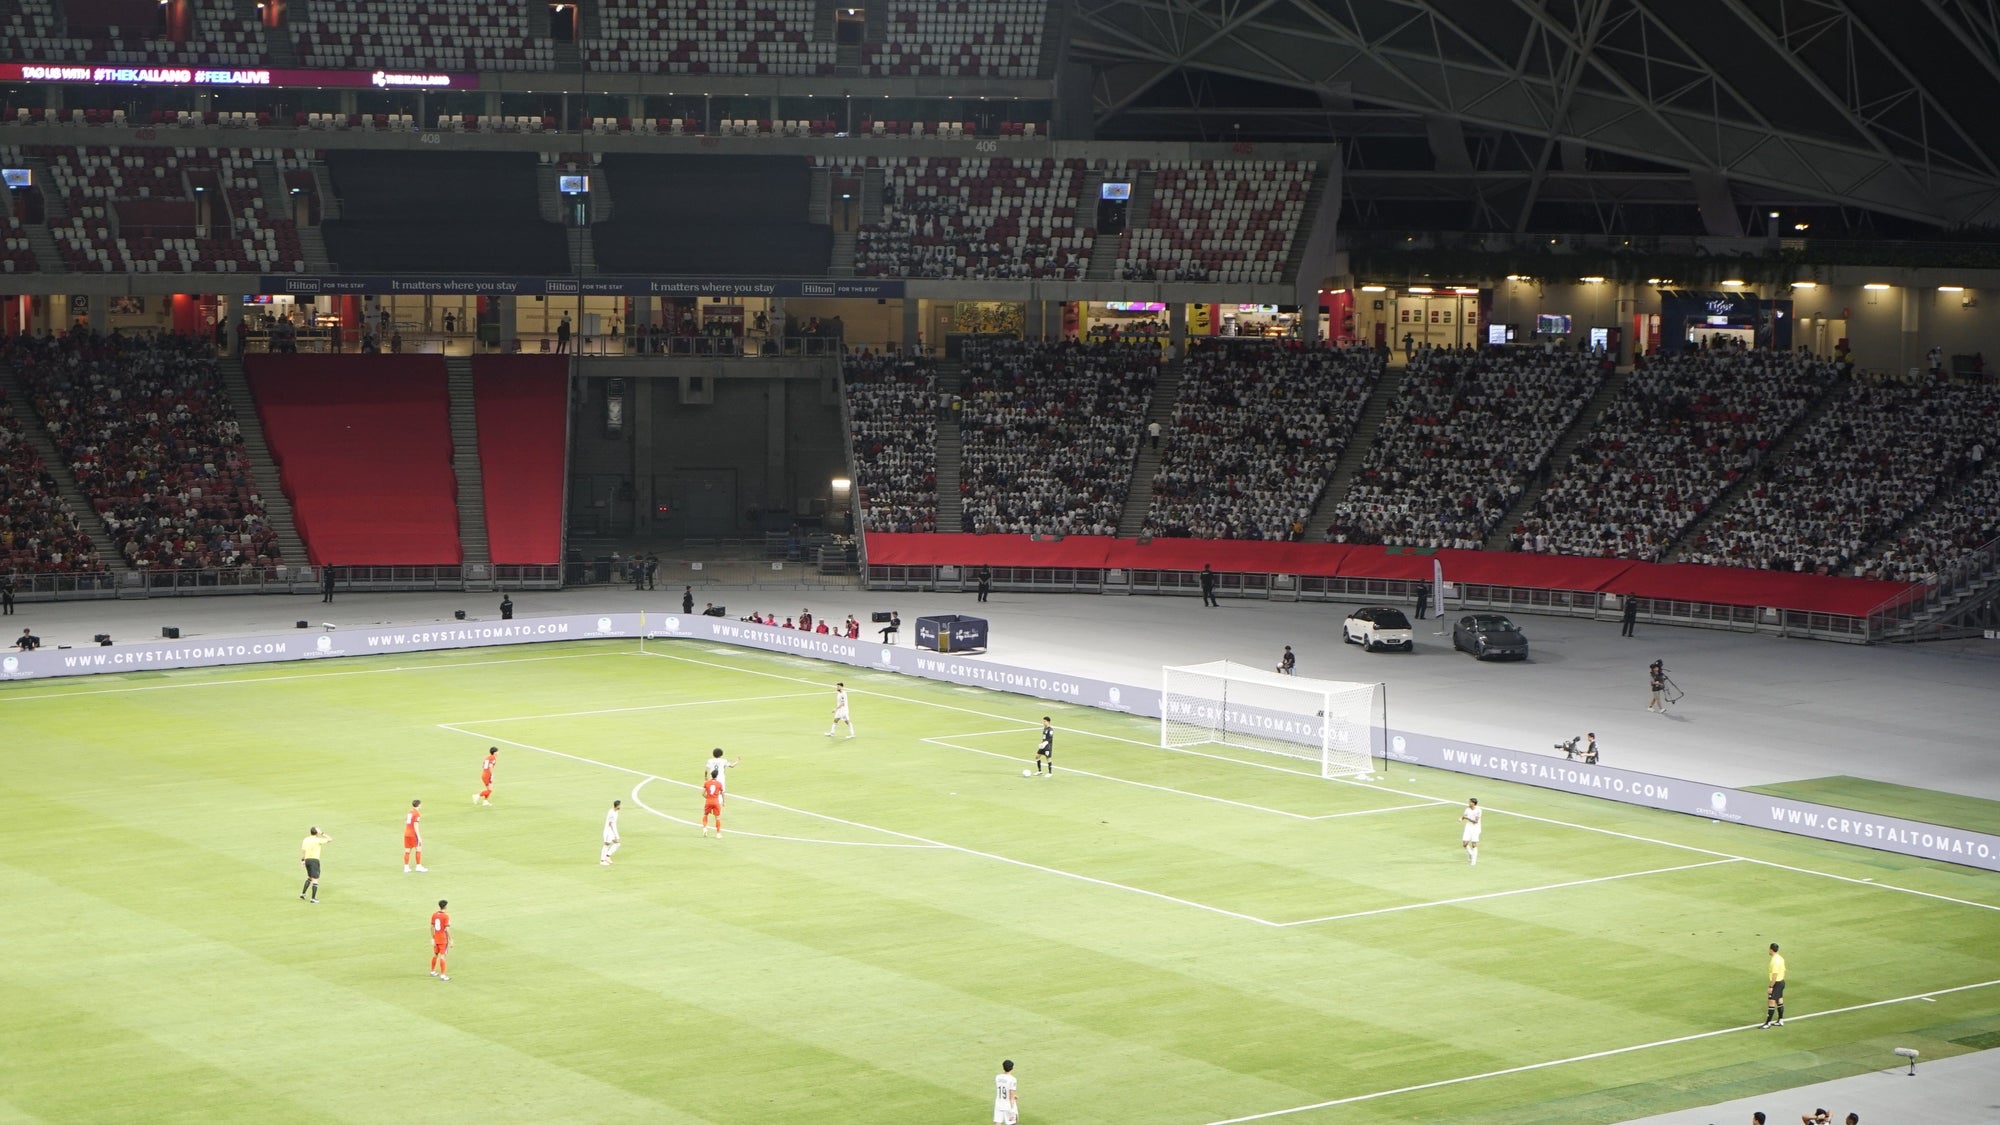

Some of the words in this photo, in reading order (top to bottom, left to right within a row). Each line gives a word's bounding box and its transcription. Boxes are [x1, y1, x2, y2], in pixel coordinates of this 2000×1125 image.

[22, 67, 45, 79] TAG
[45, 68, 61, 79] US
[62, 68, 90, 80] WITH
[94, 69, 191, 82] #THEKALLANG
[195, 70, 270, 84] #FEELALIVE
[420, 134, 440, 144] 408
[976, 141, 997, 151] 406
[289, 281, 318, 290] Hilton
[392, 280, 399, 289] It
[402, 281, 441, 290] matters
[443, 280, 474, 290] where
[476, 282, 494, 292] you
[496, 281, 517, 292] stay
[548, 282, 577, 291] Hilton
[650, 282, 659, 291] It
[660, 282, 700, 291] matters
[701, 282, 732, 292] where
[734, 284, 752, 294] you
[754, 283, 775, 294] stay
[805, 285, 833, 294] Hilton
[1705, 300, 1734, 314] Tiger
[368, 623, 568, 647] WWW.CRYSTALTOMATO.COM
[712, 623, 856, 657] WWW.CRYSTALTOMATO.COM
[65, 643, 287, 667] WWW.CRYSTALTOMATO.COM
[917, 658, 1080, 695] WWW.CRYSTALTOMATO.COM
[1443, 748, 1670, 800] WWW.CRYSTALTOMATO.COM
[434, 918, 442, 931] 8
[998, 1086, 1007, 1100] 19
